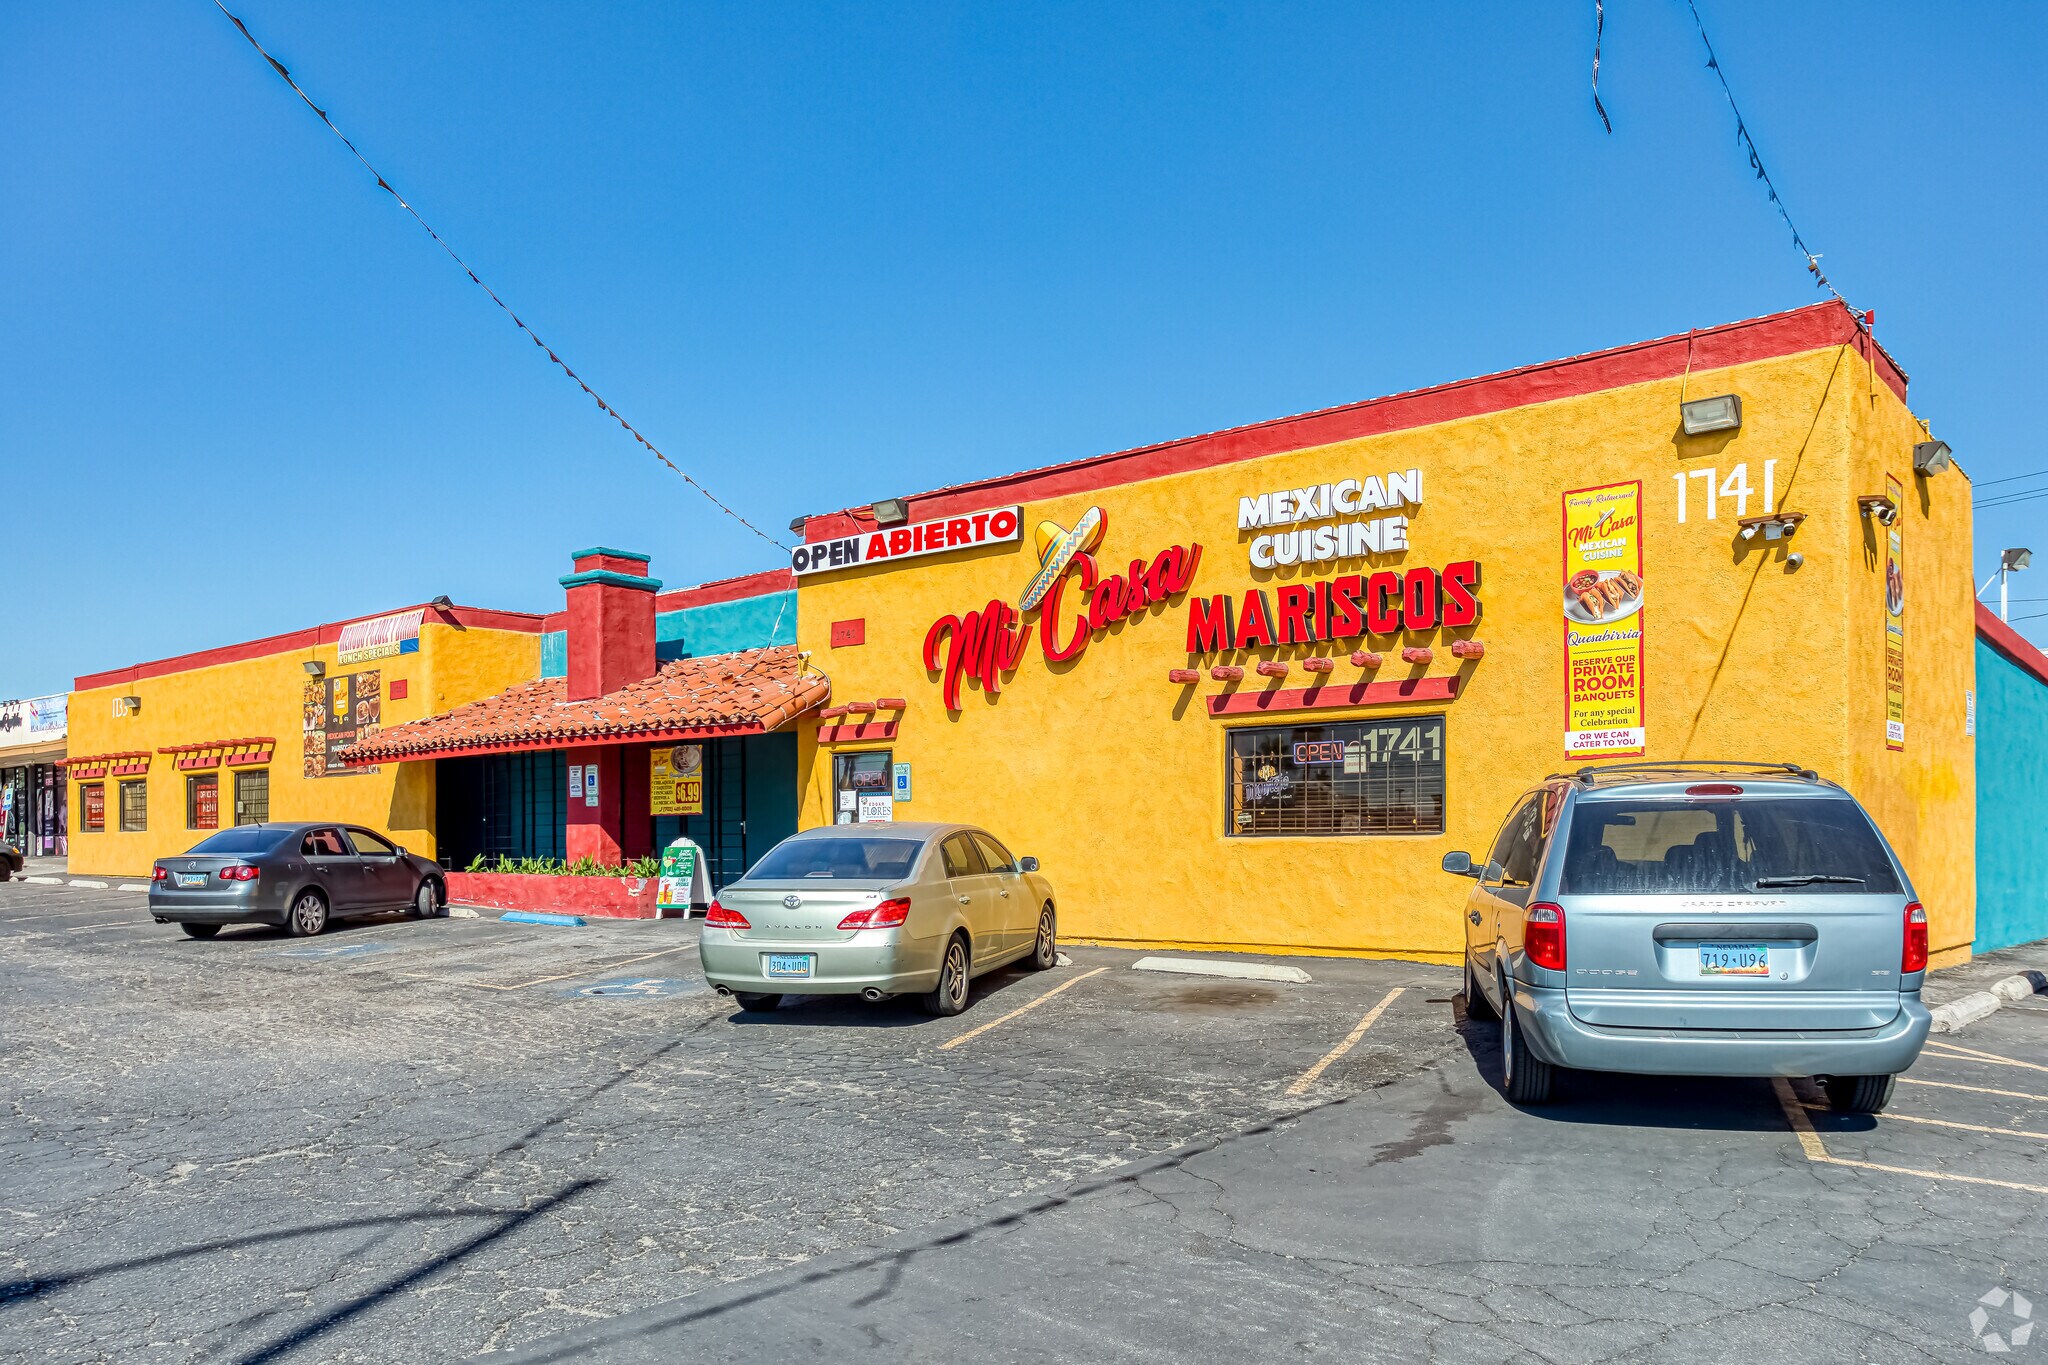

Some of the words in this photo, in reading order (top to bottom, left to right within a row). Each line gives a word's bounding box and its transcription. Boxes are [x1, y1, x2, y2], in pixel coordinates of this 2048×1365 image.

[1237, 468, 1423, 530] MEXICAN
[1568, 497, 1594, 508] Family
[1595, 490, 1635, 503] Restaurant
[1672, 459, 1778, 524] 1741
[1568, 525, 1596, 548] Mi
[1599, 514, 1637, 538] Casa
[792, 538, 860, 572] OPEN
[865, 510, 1018, 560] ABIERTO
[1249, 515, 1409, 569] CUISINE
[1579, 537, 1627, 552] MEXICAN
[1582, 548, 1623, 562] CUISINE
[1185, 560, 1483, 654] MARISCOS
[922, 599, 1032, 711] Mi
[1040, 542, 1203, 662] Casa
[1567, 629, 1643, 647] Quesabirria
[363, 643, 400, 660] SPECIALS
[1572, 656, 1613, 667] RESERVE
[1615, 654, 1636, 663] OUR
[1573, 662, 1635, 678] PRIVATE
[1573, 674, 1635, 692] ROOM
[1573, 690, 1635, 703] BANQUETS
[1573, 709, 1588, 718] For
[1590, 709, 1604, 718] any
[1606, 706, 1635, 717] special
[1580, 717, 1628, 727] Celebration
[1296, 743, 1342, 762] OPEN
[1363, 726, 1441, 763] 1741
[1573, 741, 1601, 749] CATER
[1616, 738, 1636, 746] YOU
[856, 772, 886, 787] OPEN
[676, 783, 700, 802] $6.99
[862, 806, 891, 816] FLORES
